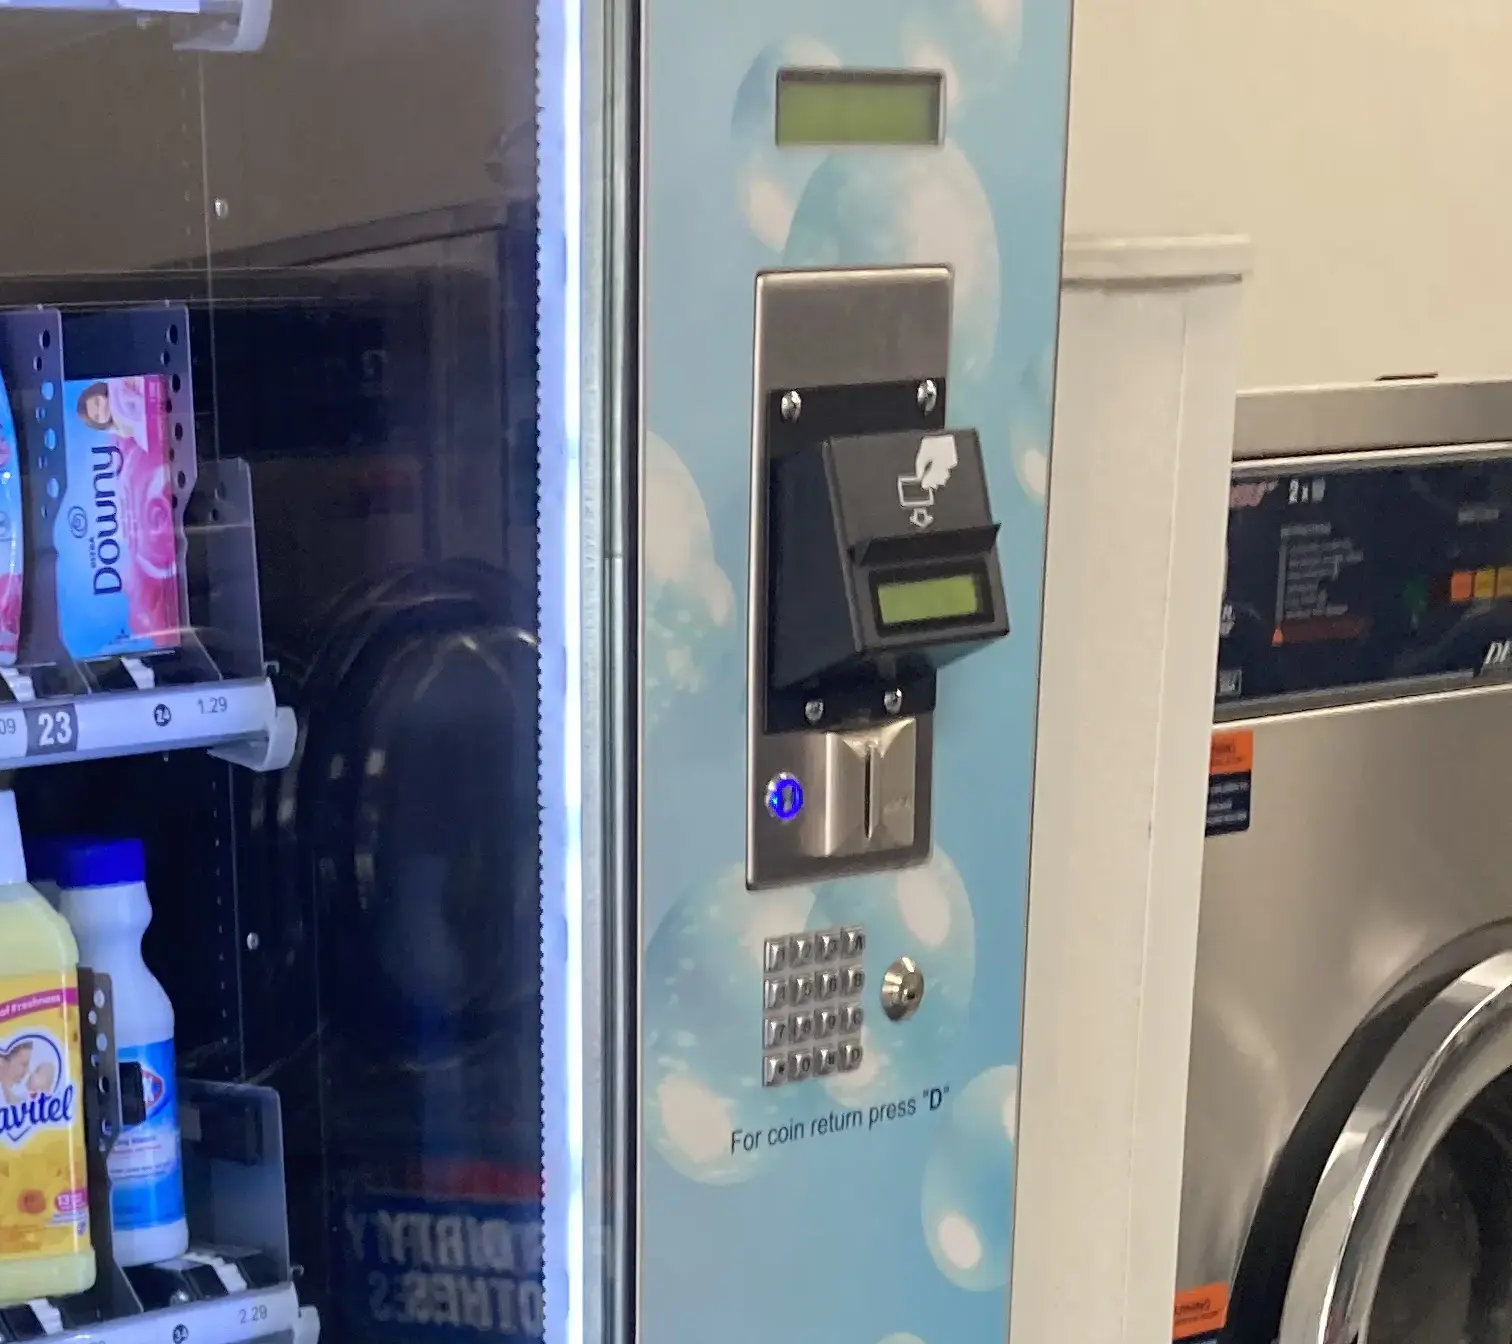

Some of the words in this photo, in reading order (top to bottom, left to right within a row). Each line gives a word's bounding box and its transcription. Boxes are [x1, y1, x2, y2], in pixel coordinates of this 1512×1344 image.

[91, 445, 124, 596] Downy
[38, 711, 72, 746] 23
[197, 697, 228, 715] 1.29
[730, 1129, 763, 1156] For
[767, 1118, 805, 1147] coin
[810, 1109, 863, 1138] return
[868, 1096, 917, 1132] press
